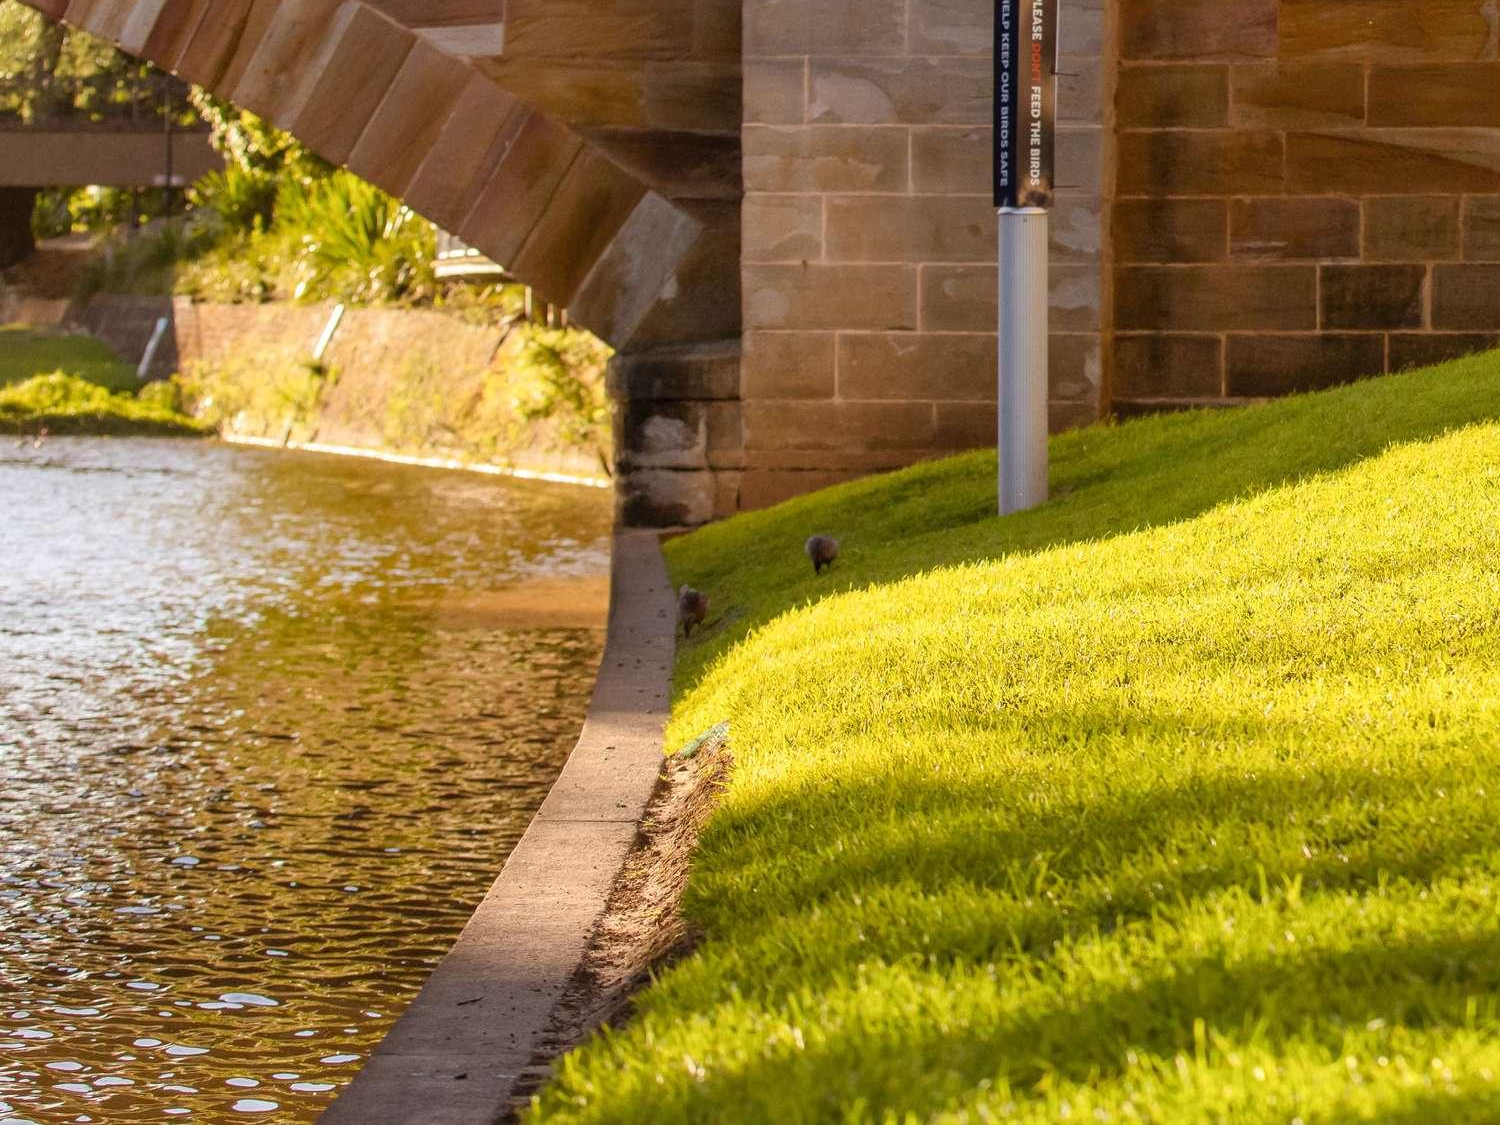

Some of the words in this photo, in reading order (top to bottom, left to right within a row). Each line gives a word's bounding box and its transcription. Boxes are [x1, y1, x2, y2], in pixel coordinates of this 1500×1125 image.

[1001, 33, 1010, 69] KEEP
[1031, 43, 1041, 84] DON'T
[1001, 71, 1010, 103] OUR
[1030, 86, 1041, 118] FEED
[1000, 106, 1009, 148] BIRDS
[1030, 120, 1041, 145] THE
[1000, 151, 1008, 187] SAFE
[1030, 148, 1040, 186] BIRDS
